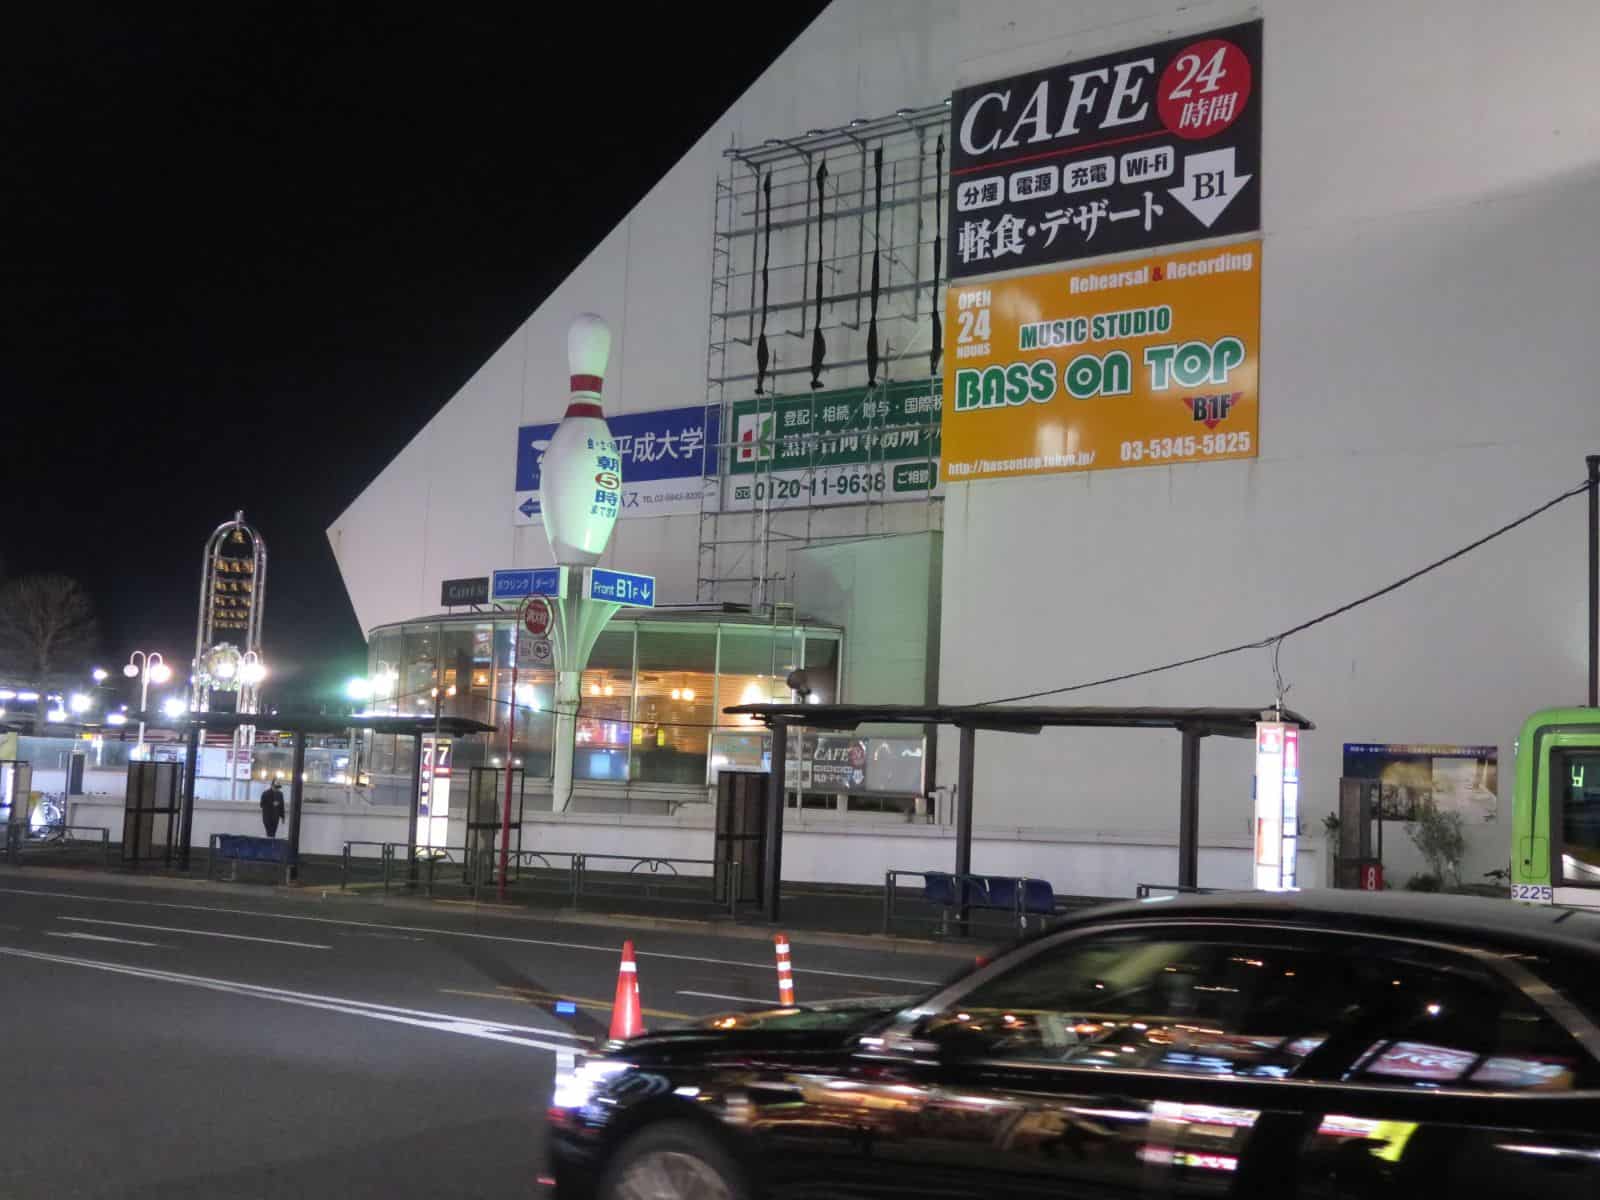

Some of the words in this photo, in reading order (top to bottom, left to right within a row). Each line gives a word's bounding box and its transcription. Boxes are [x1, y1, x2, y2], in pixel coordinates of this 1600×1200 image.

[1168, 47, 1227, 101] 24
[960, 58, 1155, 155] CAFE
[1178, 91, 1238, 129] 時間
[963, 182, 999, 205] 分煙
[1016, 173, 1052, 196] 電源
[1070, 163, 1108, 188] 充電
[1126, 153, 1168, 176] Wi-Fi
[1192, 170, 1228, 201] B1
[958, 191, 1165, 264] 軽食・デザート
[1070, 267, 1148, 294] Rehearsal
[1152, 267, 1163, 282] &
[1166, 252, 1253, 280] Recording
[958, 289, 992, 310] OPEN
[958, 309, 992, 344] 24
[1019, 317, 1090, 351] MUSIC
[1092, 306, 1173, 341] STUDIO
[955, 359, 1057, 412] BASS
[1144, 336, 1245, 391] TOP
[1193, 394, 1231, 421] B1F
[594, 581, 614, 596] Front
[424, 747, 432, 767] 7
[438, 746, 449, 766] 7
[814, 748, 849, 762] CAFE
[1367, 867, 1376, 890] 8
